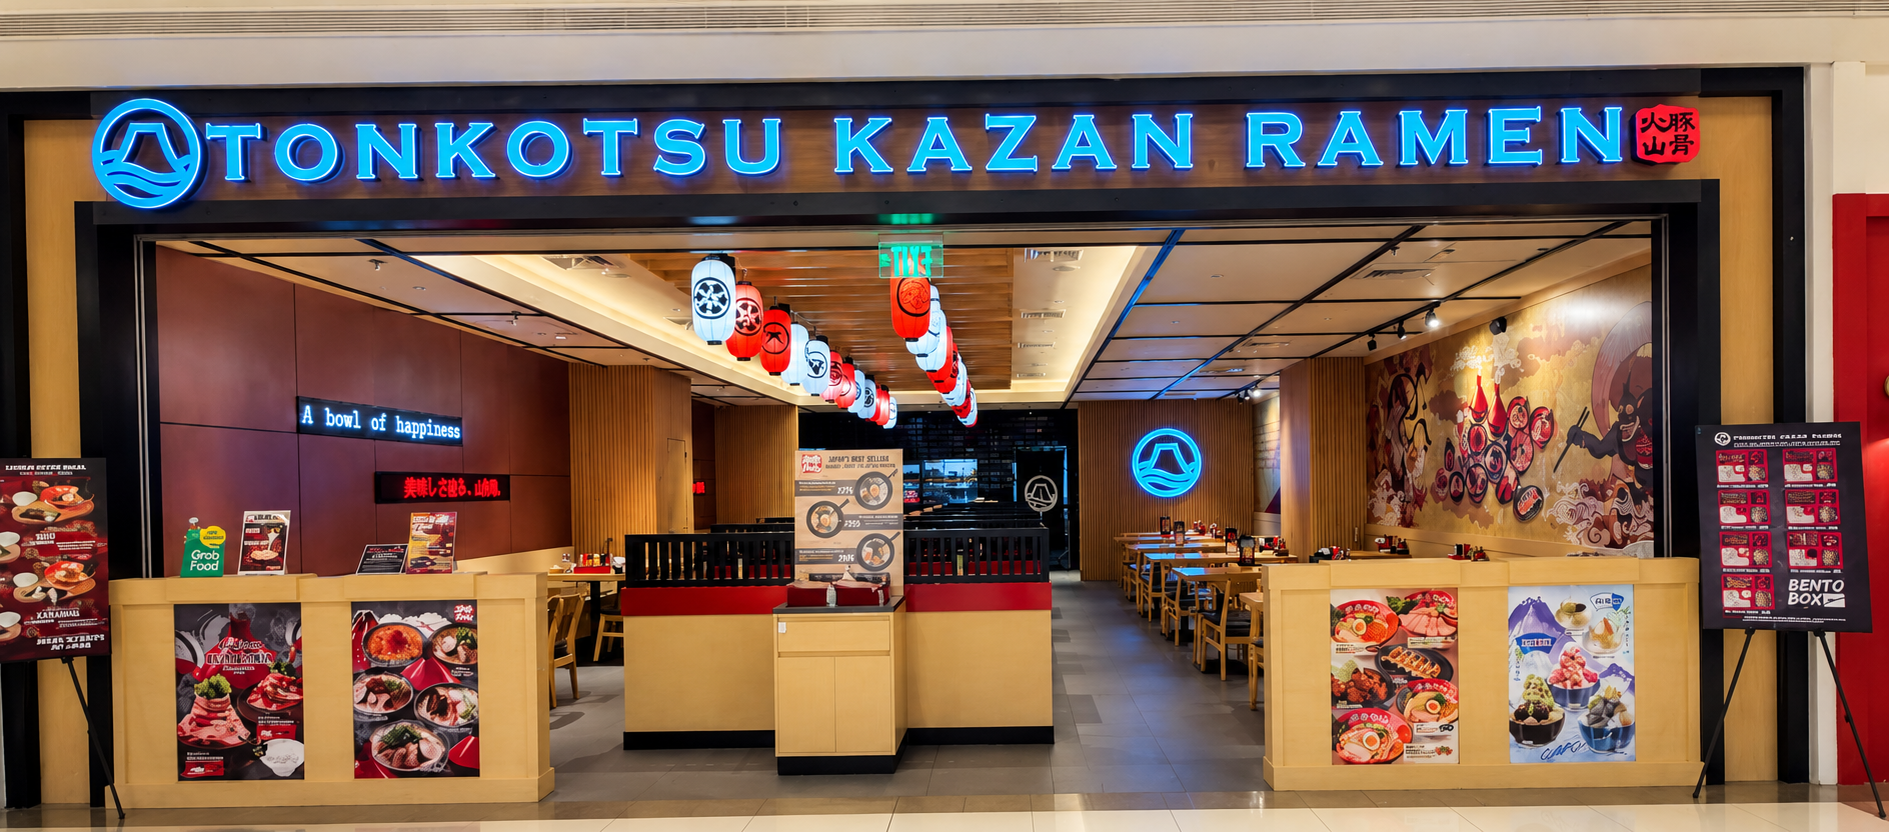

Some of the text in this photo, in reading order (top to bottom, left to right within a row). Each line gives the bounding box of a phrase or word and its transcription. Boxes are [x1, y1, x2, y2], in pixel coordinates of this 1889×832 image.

[206, 106, 1622, 181] TONKOTSU KAZAN RAMEN
[301, 405, 461, 439] A bowl of happiness
[190, 560, 219, 571] Food
[1788, 579, 1844, 593] BENTO
[1788, 592, 1822, 606] BOX
